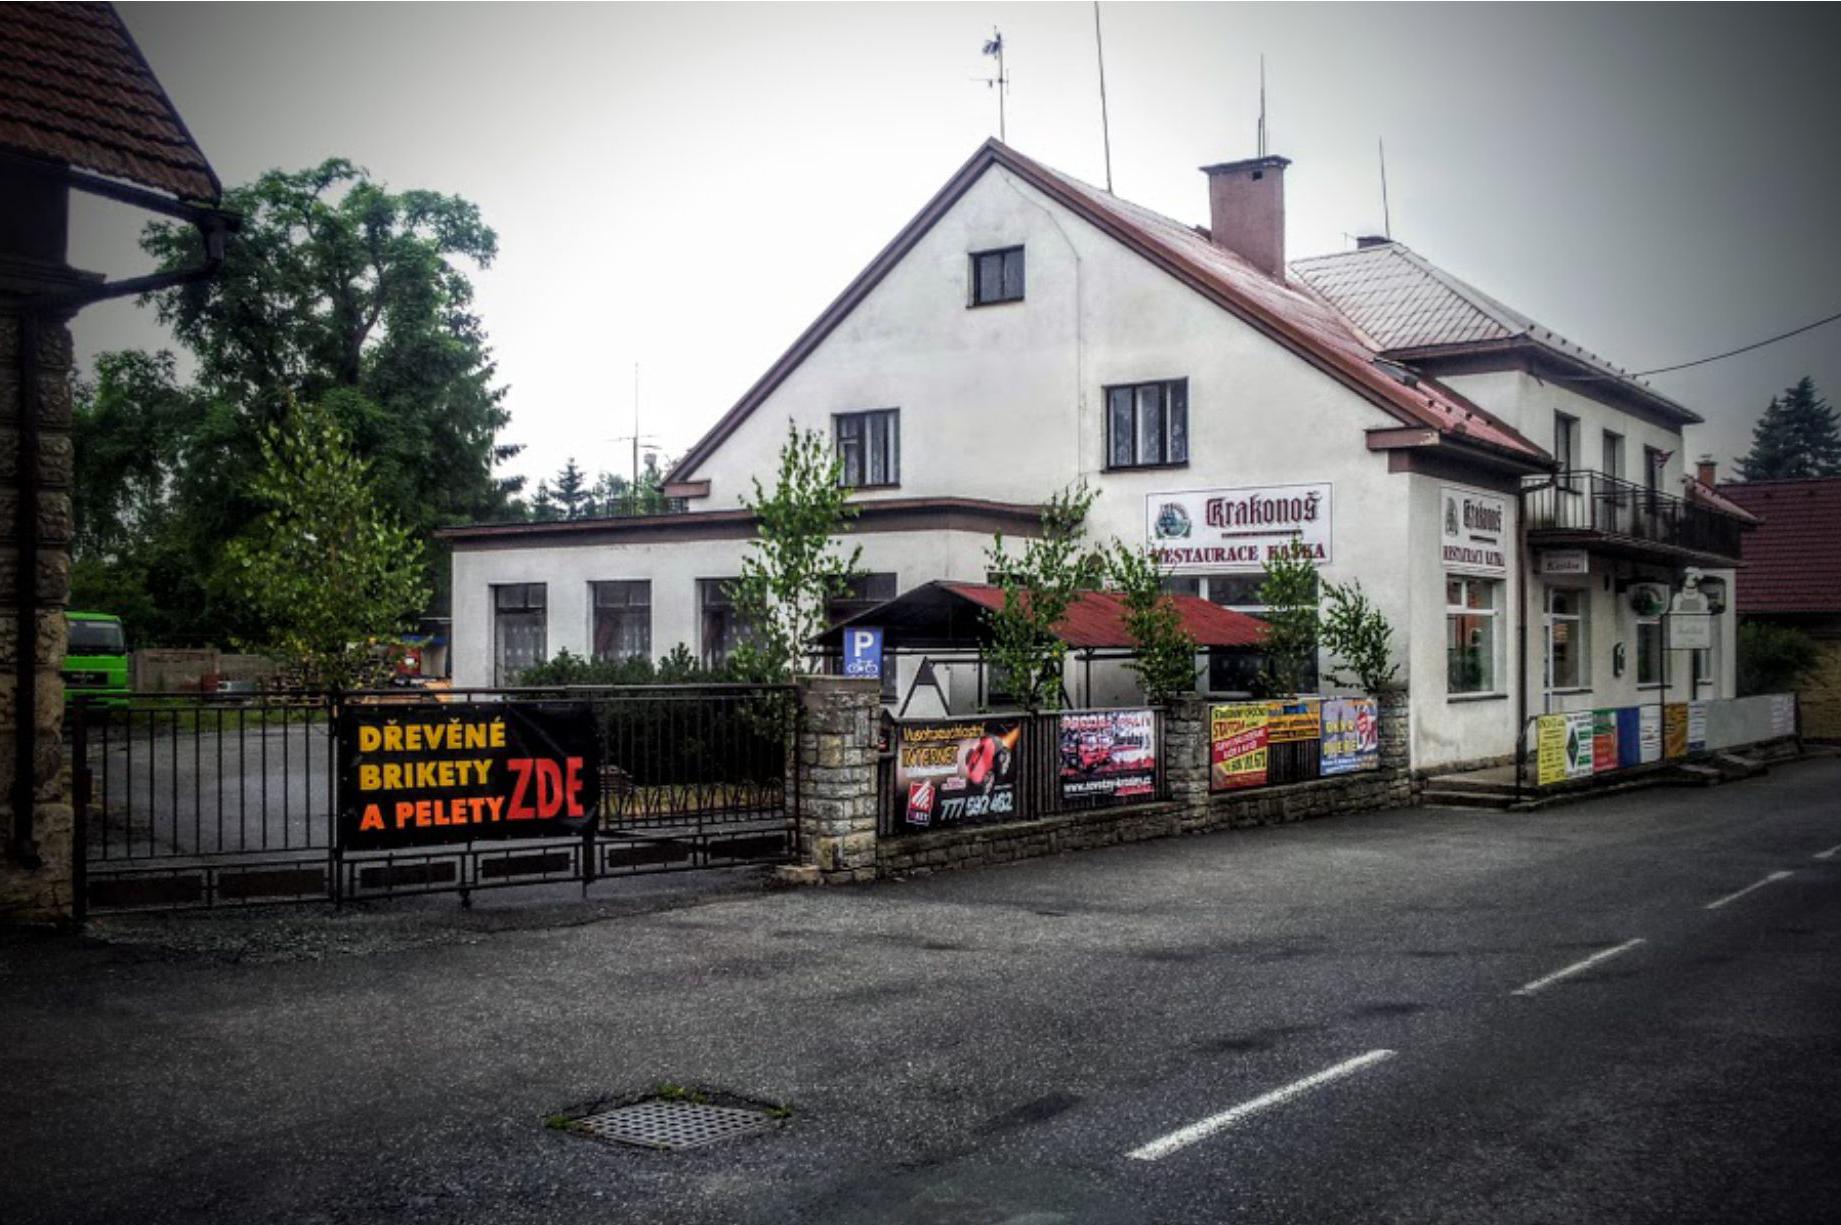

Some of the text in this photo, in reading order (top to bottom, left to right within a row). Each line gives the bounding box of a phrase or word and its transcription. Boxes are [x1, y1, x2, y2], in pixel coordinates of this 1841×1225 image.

[1206, 491, 1322, 528] Krakonoš
[853, 630, 874, 658] P
[358, 716, 506, 752] DŘEVĚNÉ
[901, 745, 959, 768] INTERNET
[359, 758, 493, 791] BRIKETY
[506, 756, 585, 820] ZDE
[359, 796, 505, 831] A PELETY
[940, 798, 966, 820] 777
